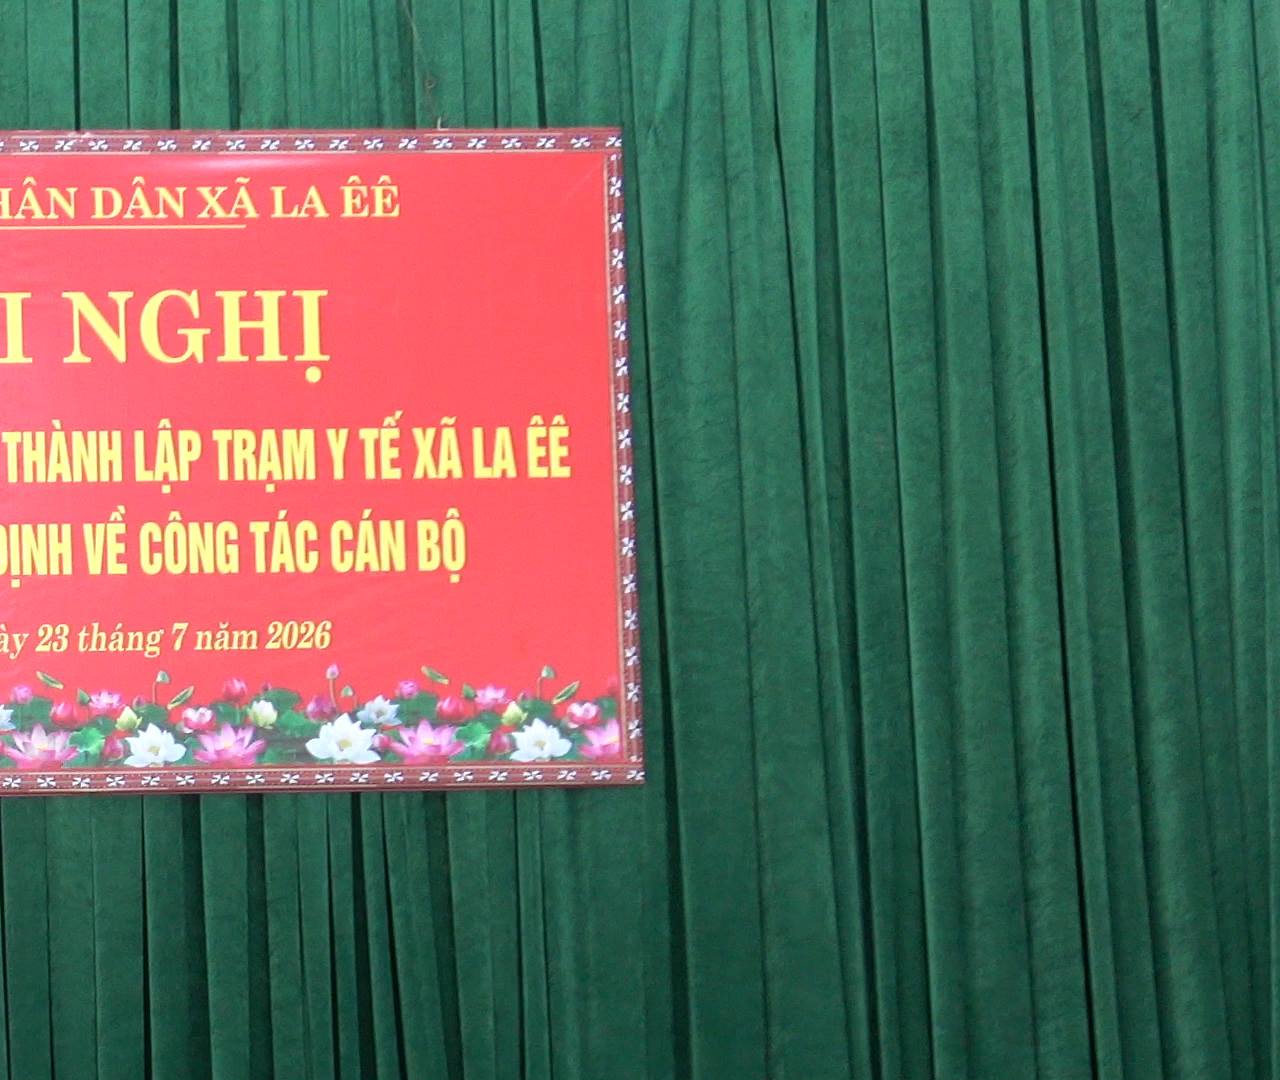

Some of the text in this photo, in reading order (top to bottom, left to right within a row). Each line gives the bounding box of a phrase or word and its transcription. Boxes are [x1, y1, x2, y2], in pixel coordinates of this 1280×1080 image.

[90, 175, 187, 219] DÂN
[196, 176, 259, 219] XÃ
[271, 185, 329, 218] LA
[340, 174, 400, 218] ÊÊ
[62, 289, 330, 384] NGHỊ
[1, 419, 123, 484] THÀNH
[134, 418, 202, 494] LẬP
[212, 428, 316, 493] TRẠM
[326, 428, 349, 481] Y
[358, 410, 403, 480] TẾ
[412, 416, 463, 480] XÃ
[472, 426, 517, 479] LA
[526, 414, 571, 478] ÊÊ
[82, 505, 128, 576] VỀ
[139, 510, 240, 576] CÔNG
[249, 509, 319, 574] TÁC
[330, 508, 406, 573] CÁN
[416, 507, 466, 584] BỘ
[35, 623, 70, 652] 23
[78, 621, 165, 659] tháng
[171, 622, 189, 651] 7
[194, 621, 259, 652] năm
[265, 620, 333, 650] 2026
